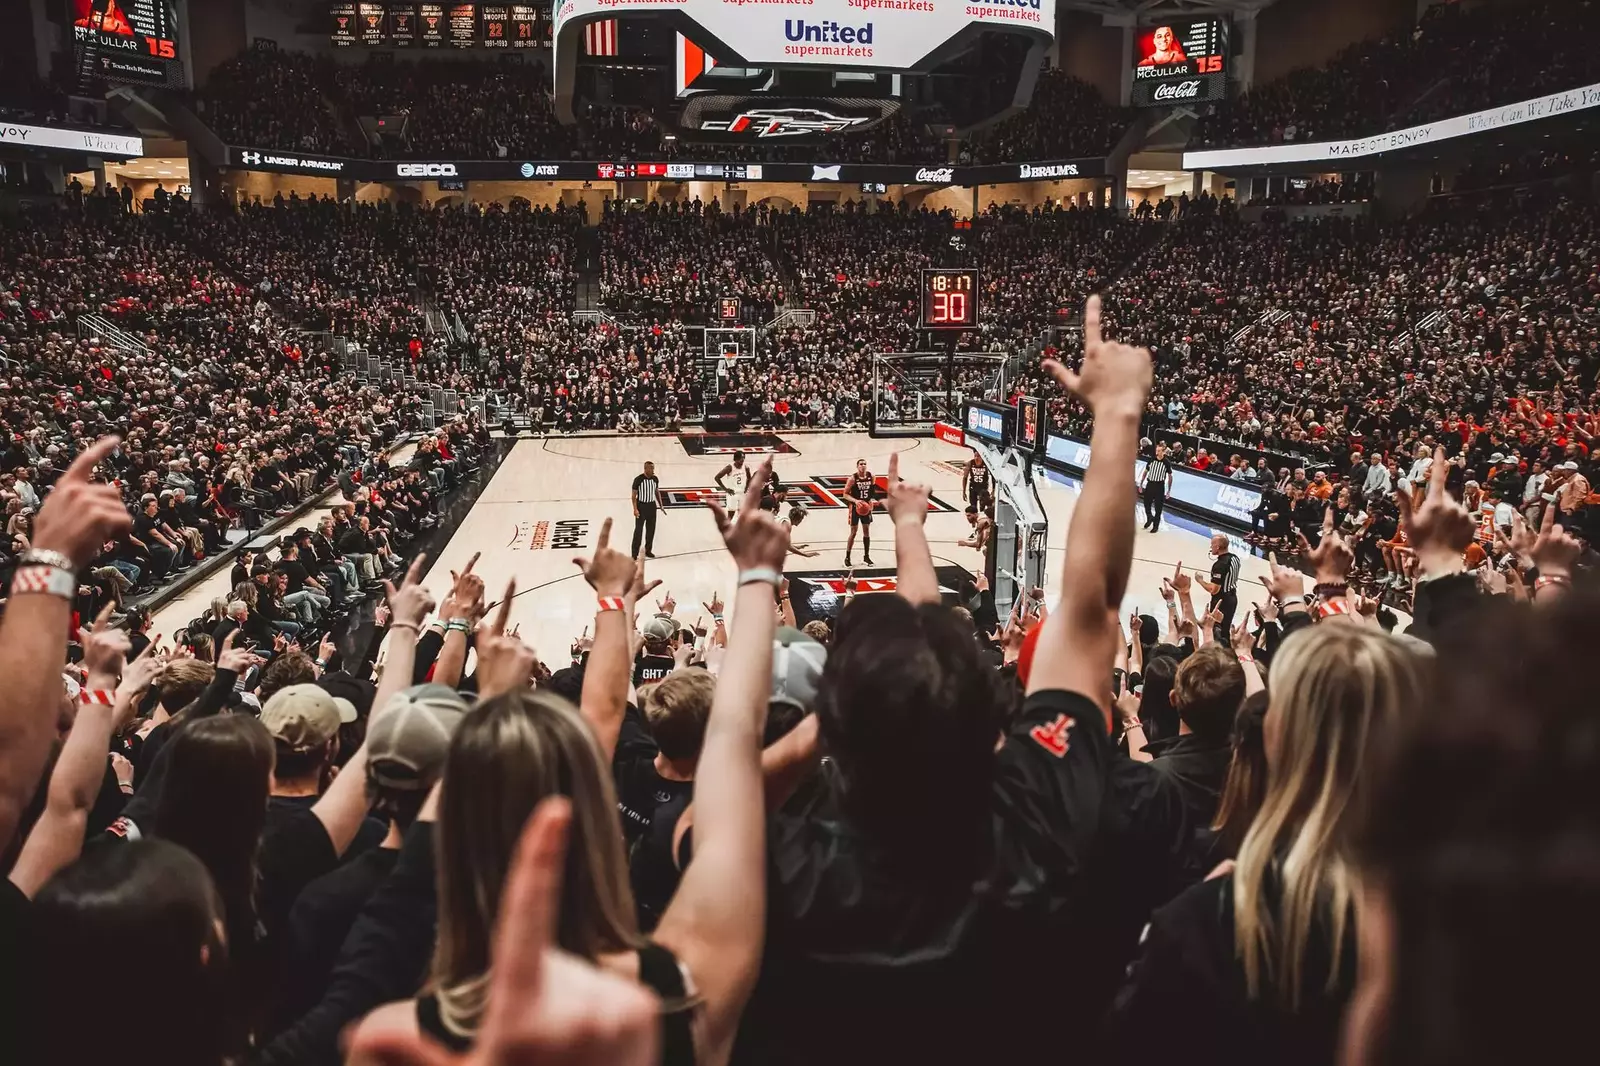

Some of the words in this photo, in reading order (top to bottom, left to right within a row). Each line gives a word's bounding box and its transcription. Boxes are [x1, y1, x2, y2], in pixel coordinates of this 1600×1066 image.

[966, 6, 1040, 22] supermarkets
[489, 23, 502, 37] 22
[519, 23, 531, 37] 21
[784, 20, 873, 45] United
[145, 36, 175, 58] 15
[784, 44, 873, 58] supermarkets
[1196, 56, 1222, 73] 15
[1137, 66, 1188, 79] MCCULLAR
[1468, 115, 1499, 129] Where
[1501, 110, 1523, 122] Can
[1528, 101, 1543, 115] We
[1548, 94, 1576, 112] Take
[1329, 138, 1387, 156] MARRIOTT
[1391, 127, 1432, 146] BONVOY
[264, 156, 298, 167] UNDER
[300, 159, 342, 171] ARMOUR
[535, 166, 559, 175] AT&T
[933, 276, 970, 291] 18:17
[723, 306, 735, 317] 30
[934, 293, 964, 321] 30
[860, 490, 868, 498] 15
[551, 519, 588, 549] United
